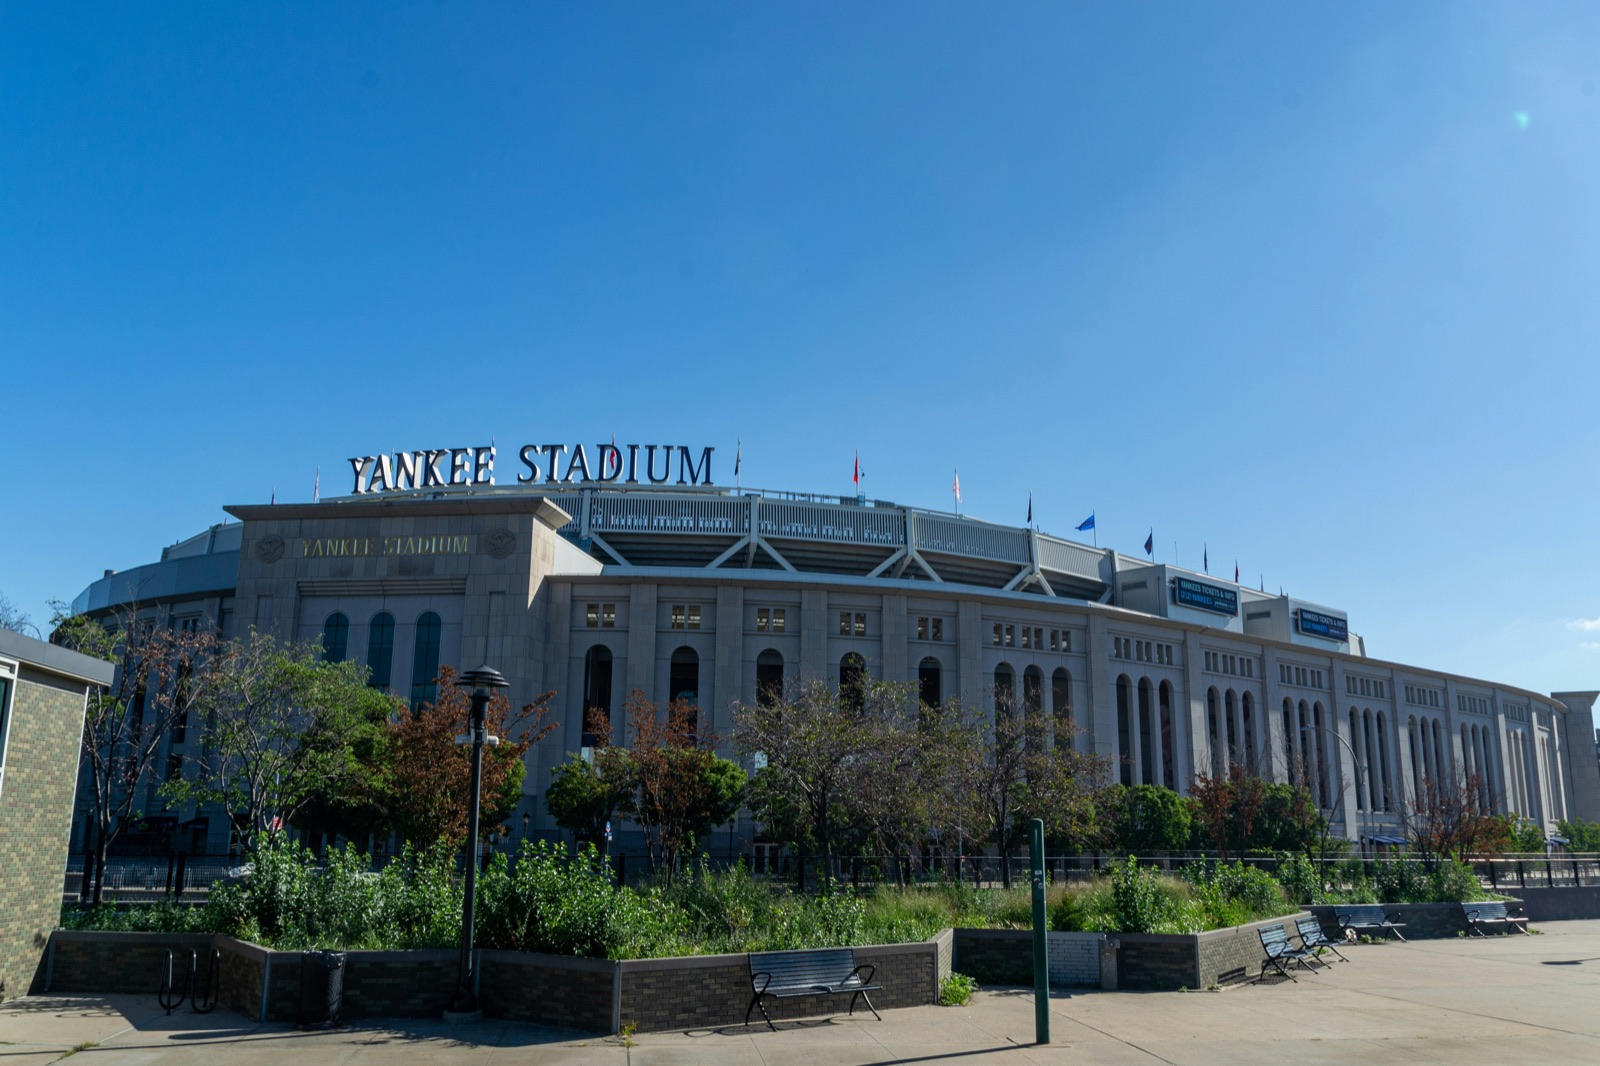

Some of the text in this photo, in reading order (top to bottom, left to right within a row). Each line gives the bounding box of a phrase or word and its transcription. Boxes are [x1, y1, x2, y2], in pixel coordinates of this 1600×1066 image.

[348, 444, 715, 494] YANKEE STADIUM
[303, 535, 468, 557] YANKEE STADIUM
[1181, 581, 1201, 592] YANKEES
[1202, 586, 1219, 597] TICKETS
